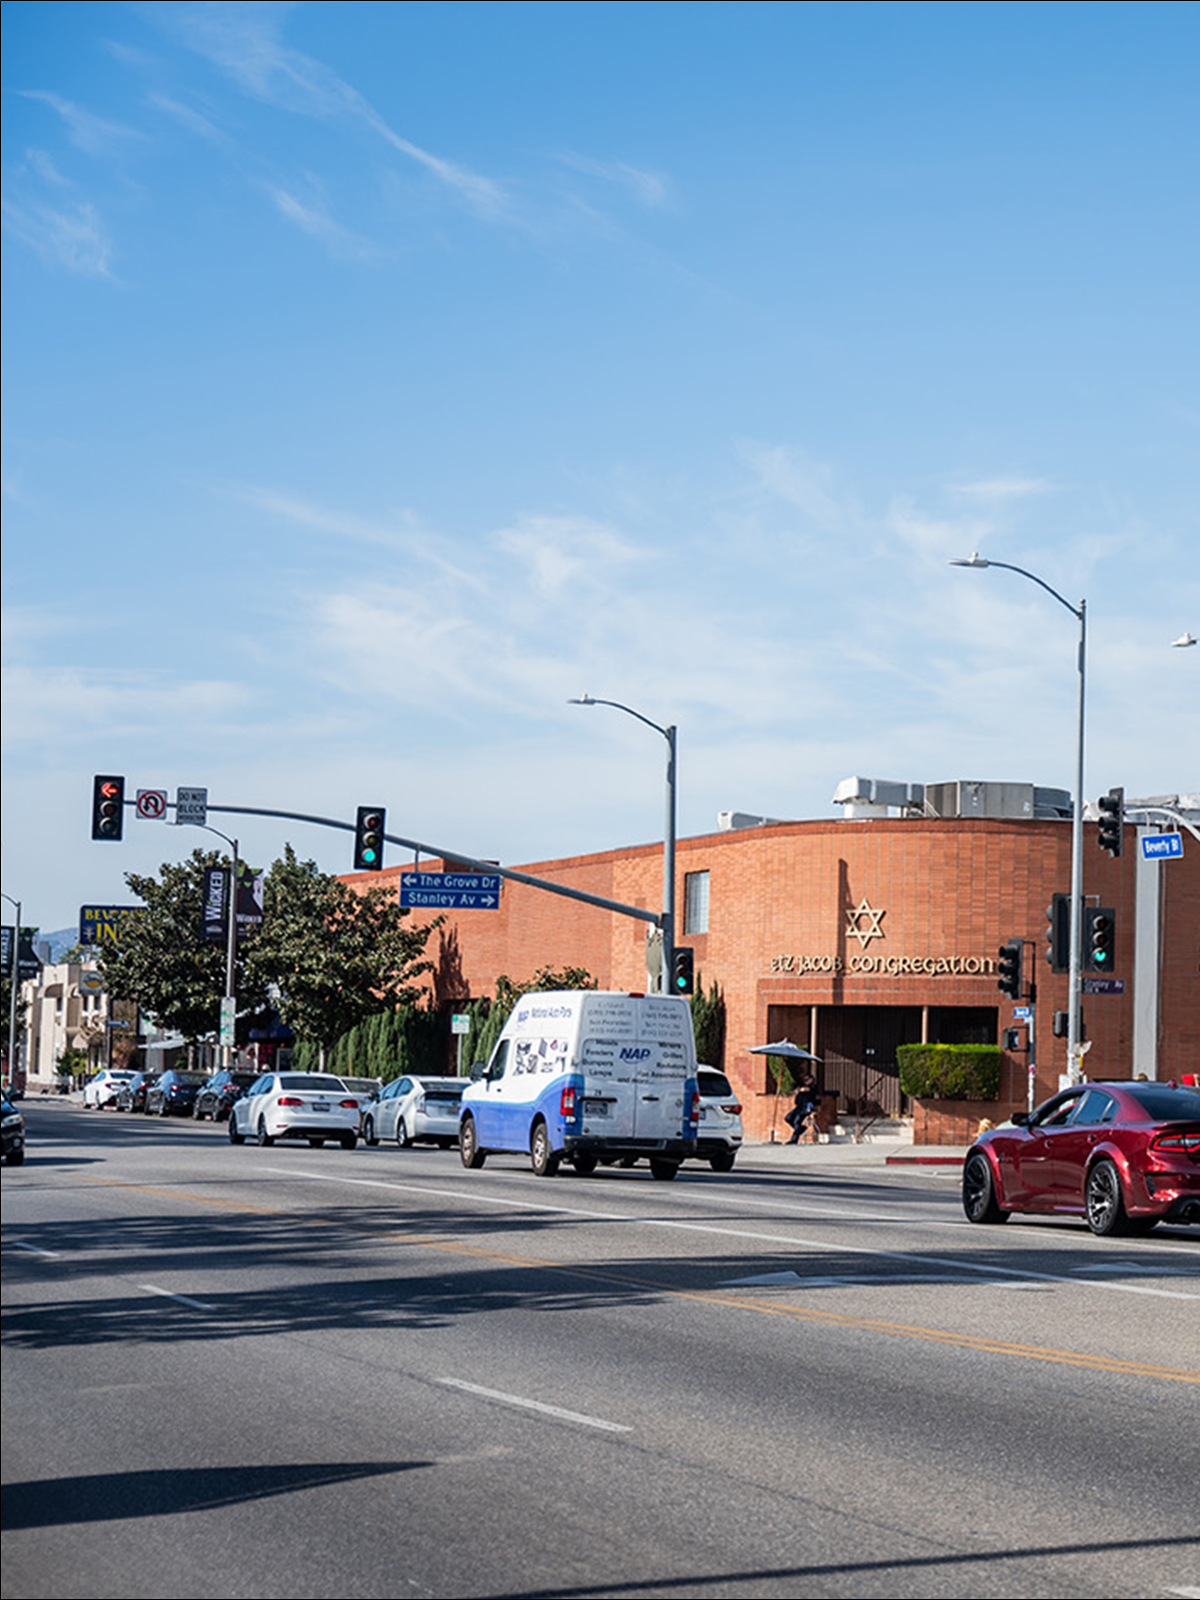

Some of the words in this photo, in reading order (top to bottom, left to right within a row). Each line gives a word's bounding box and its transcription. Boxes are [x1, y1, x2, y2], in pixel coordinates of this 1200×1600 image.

[178, 804, 206, 814] BLOCK
[1144, 840, 1170, 854] Beverly
[420, 875, 441, 887] The
[444, 875, 479, 888] Grove
[482, 876, 497, 889] Dr
[408, 891, 456, 907] Stanley
[460, 893, 476, 905] Av
[585, 1048, 614, 1056] Fenders
[619, 1047, 651, 1060] NAP
